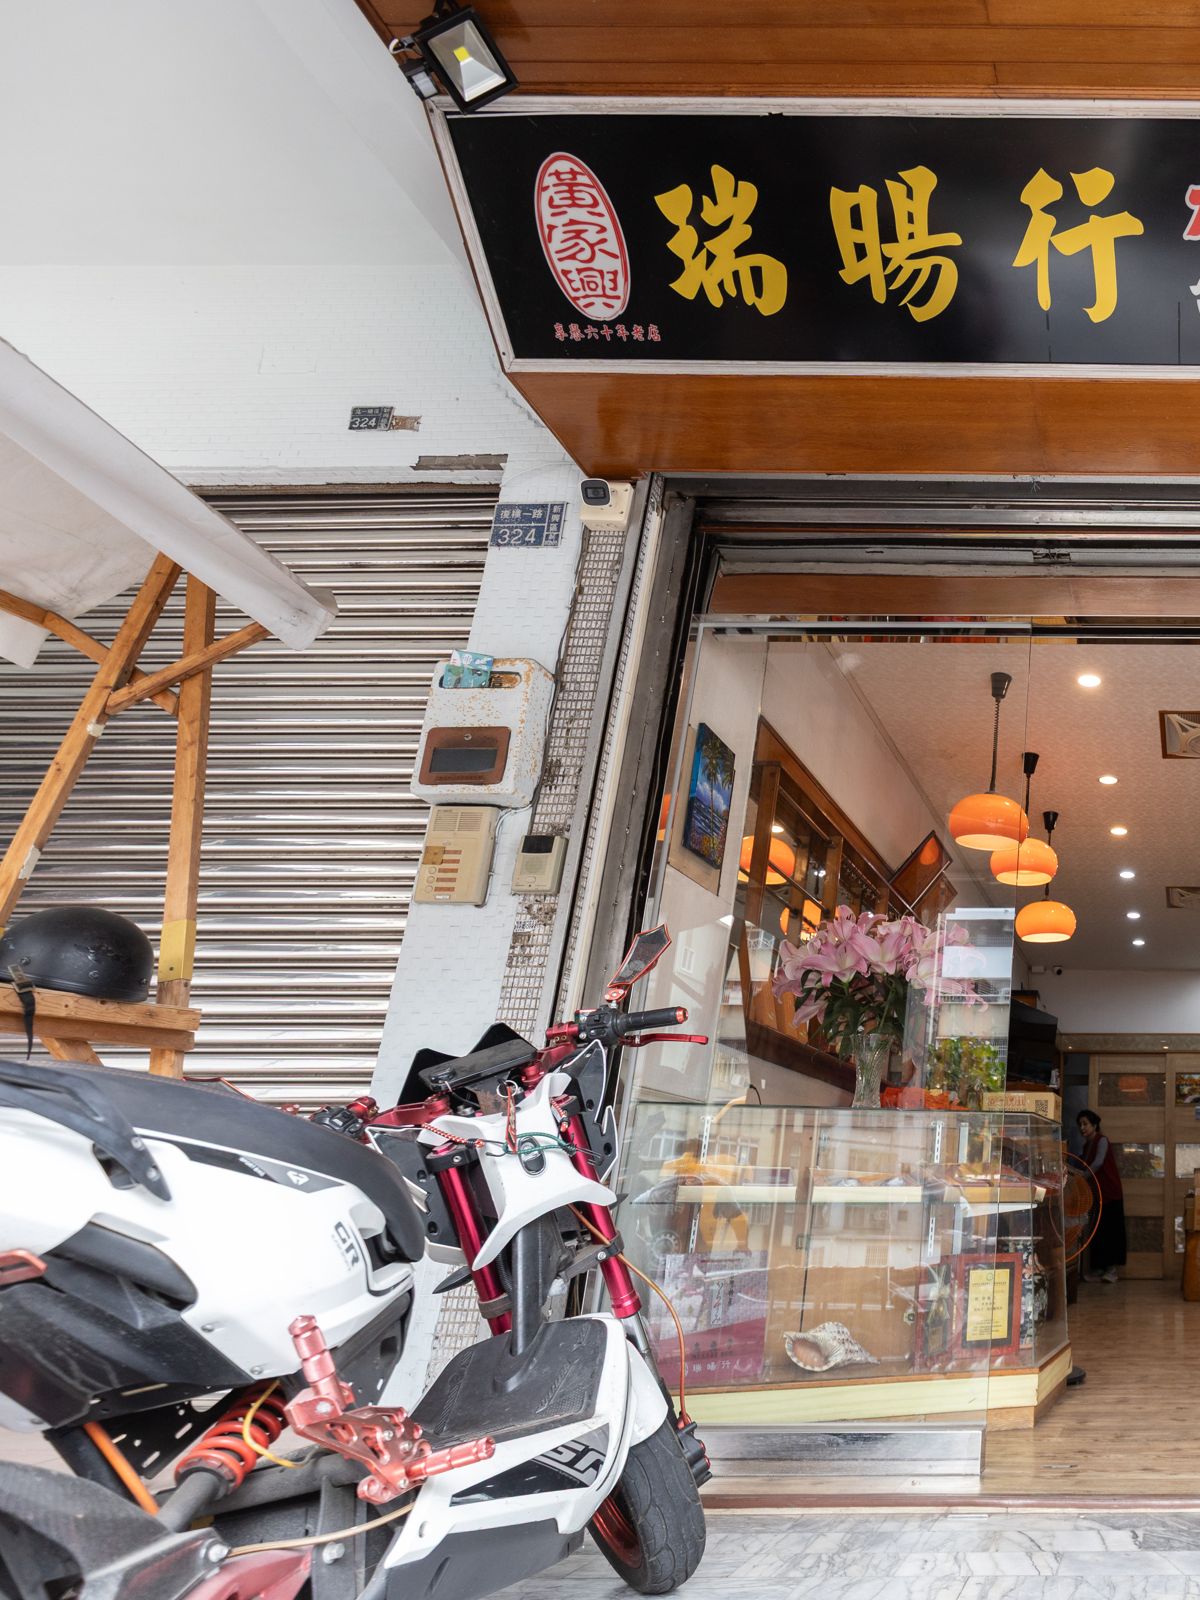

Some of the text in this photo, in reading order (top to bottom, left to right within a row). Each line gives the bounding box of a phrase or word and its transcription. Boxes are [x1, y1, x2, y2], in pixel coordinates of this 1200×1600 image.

[654, 165, 1145, 323] 瑞暘行
[352, 417, 376, 428] 324
[497, 528, 537, 545] 324
[334, 1221, 360, 1267] GR
